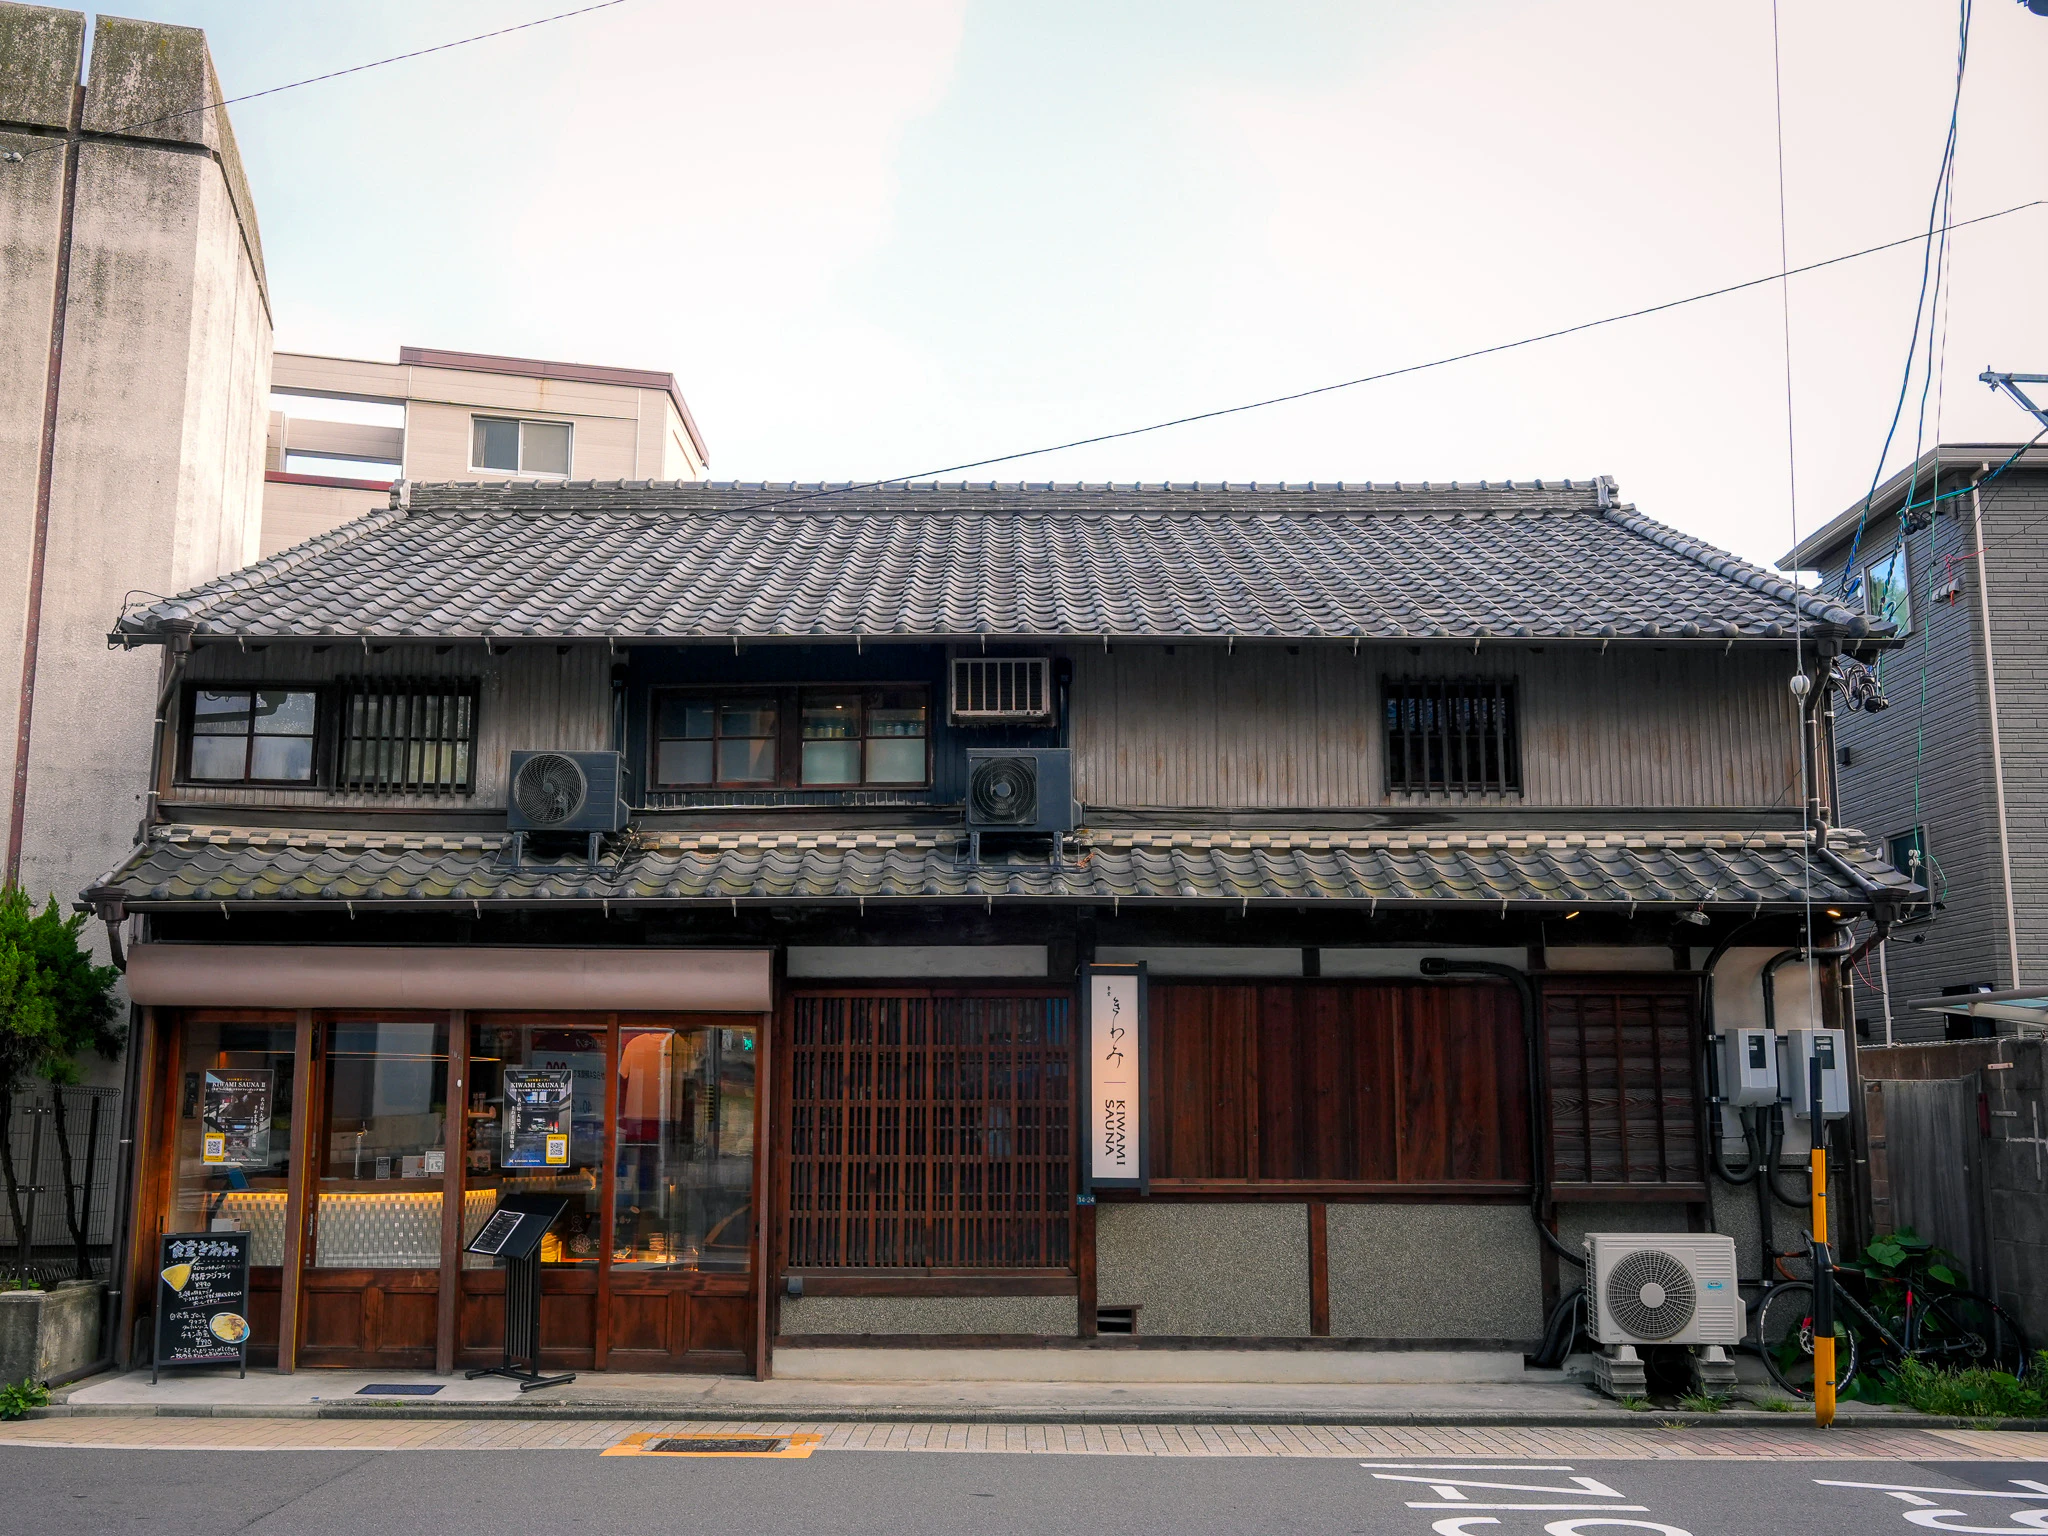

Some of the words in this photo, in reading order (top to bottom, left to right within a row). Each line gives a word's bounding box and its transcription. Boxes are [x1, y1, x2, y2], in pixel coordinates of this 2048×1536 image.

[1105, 1099, 1115, 1156] SAUNA
[1116, 1099, 1126, 1166] KIWAMI
[1078, 1196, 1095, 1204] 14-24
[168, 1240, 239, 1258] 食堂きわみ
